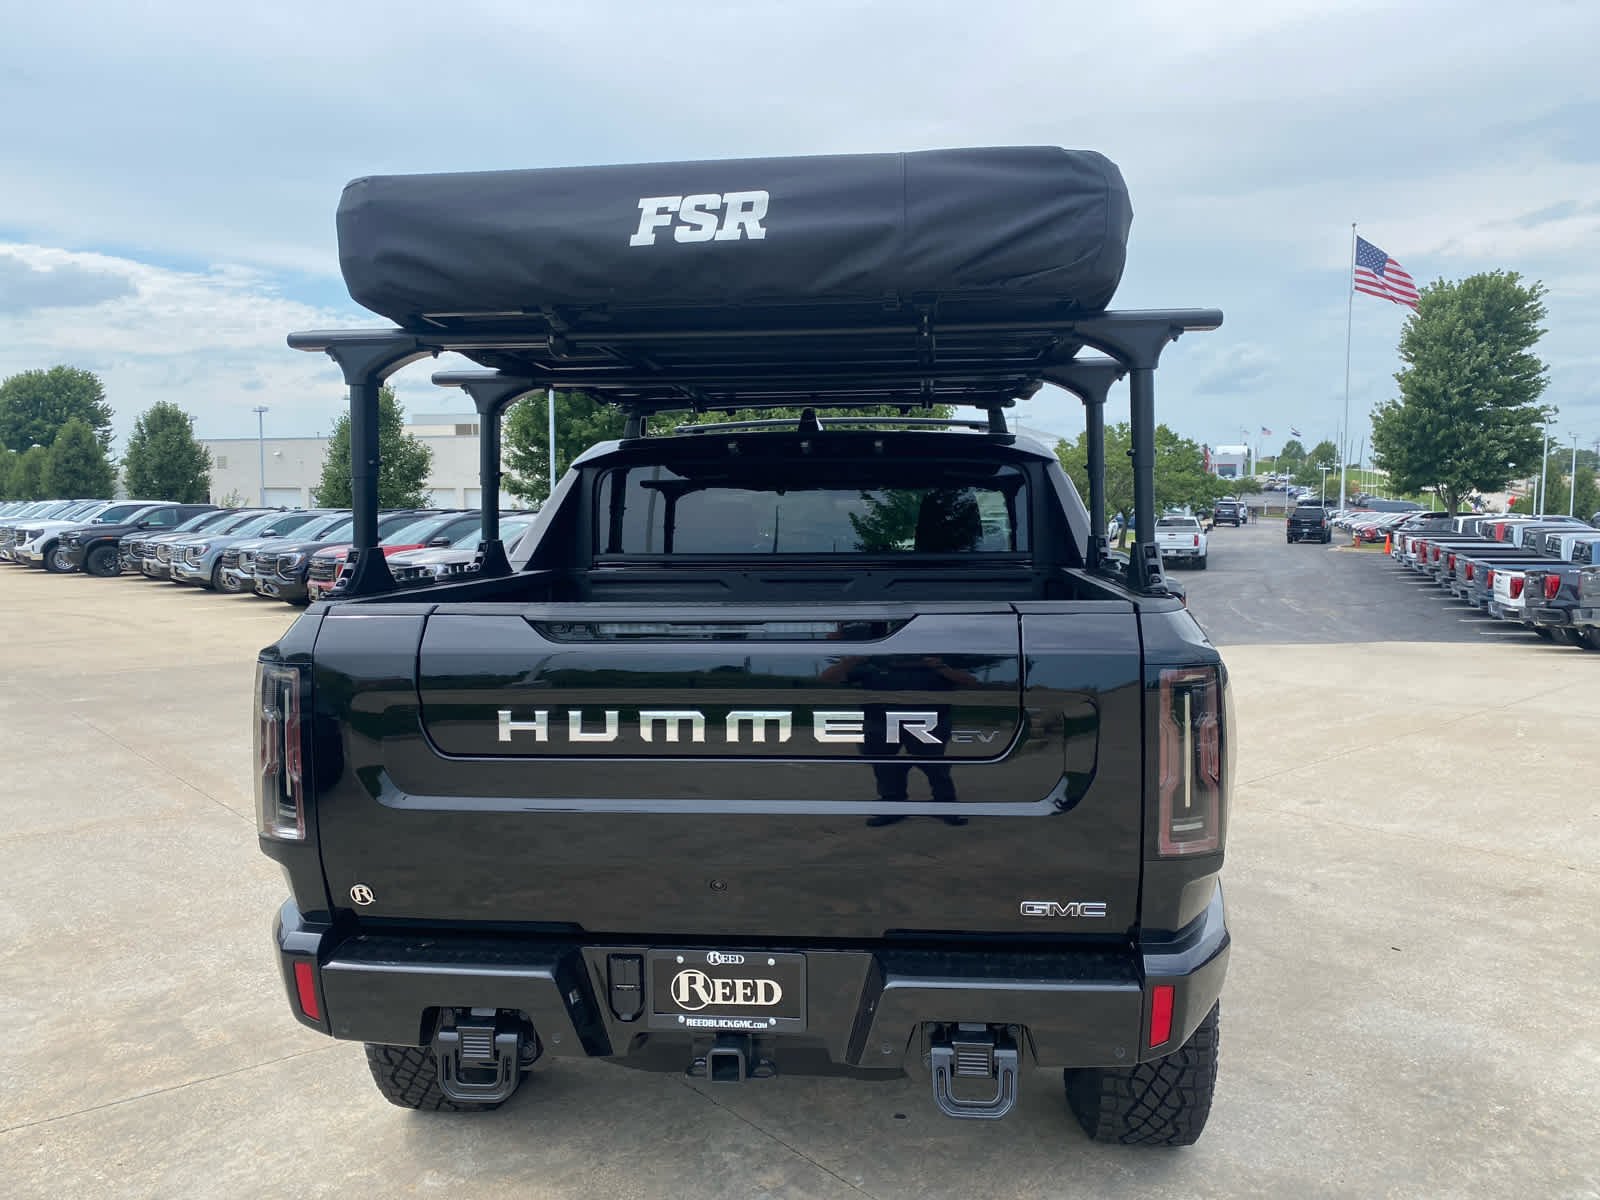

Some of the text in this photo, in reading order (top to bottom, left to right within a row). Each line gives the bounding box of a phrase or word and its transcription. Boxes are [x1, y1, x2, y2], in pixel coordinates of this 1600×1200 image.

[629, 190, 770, 247] FSR
[498, 709, 1000, 744] HUMMER EV
[1020, 901, 1107, 917] GMC
[706, 951, 745, 966] REED
[672, 970, 783, 1009] REED
